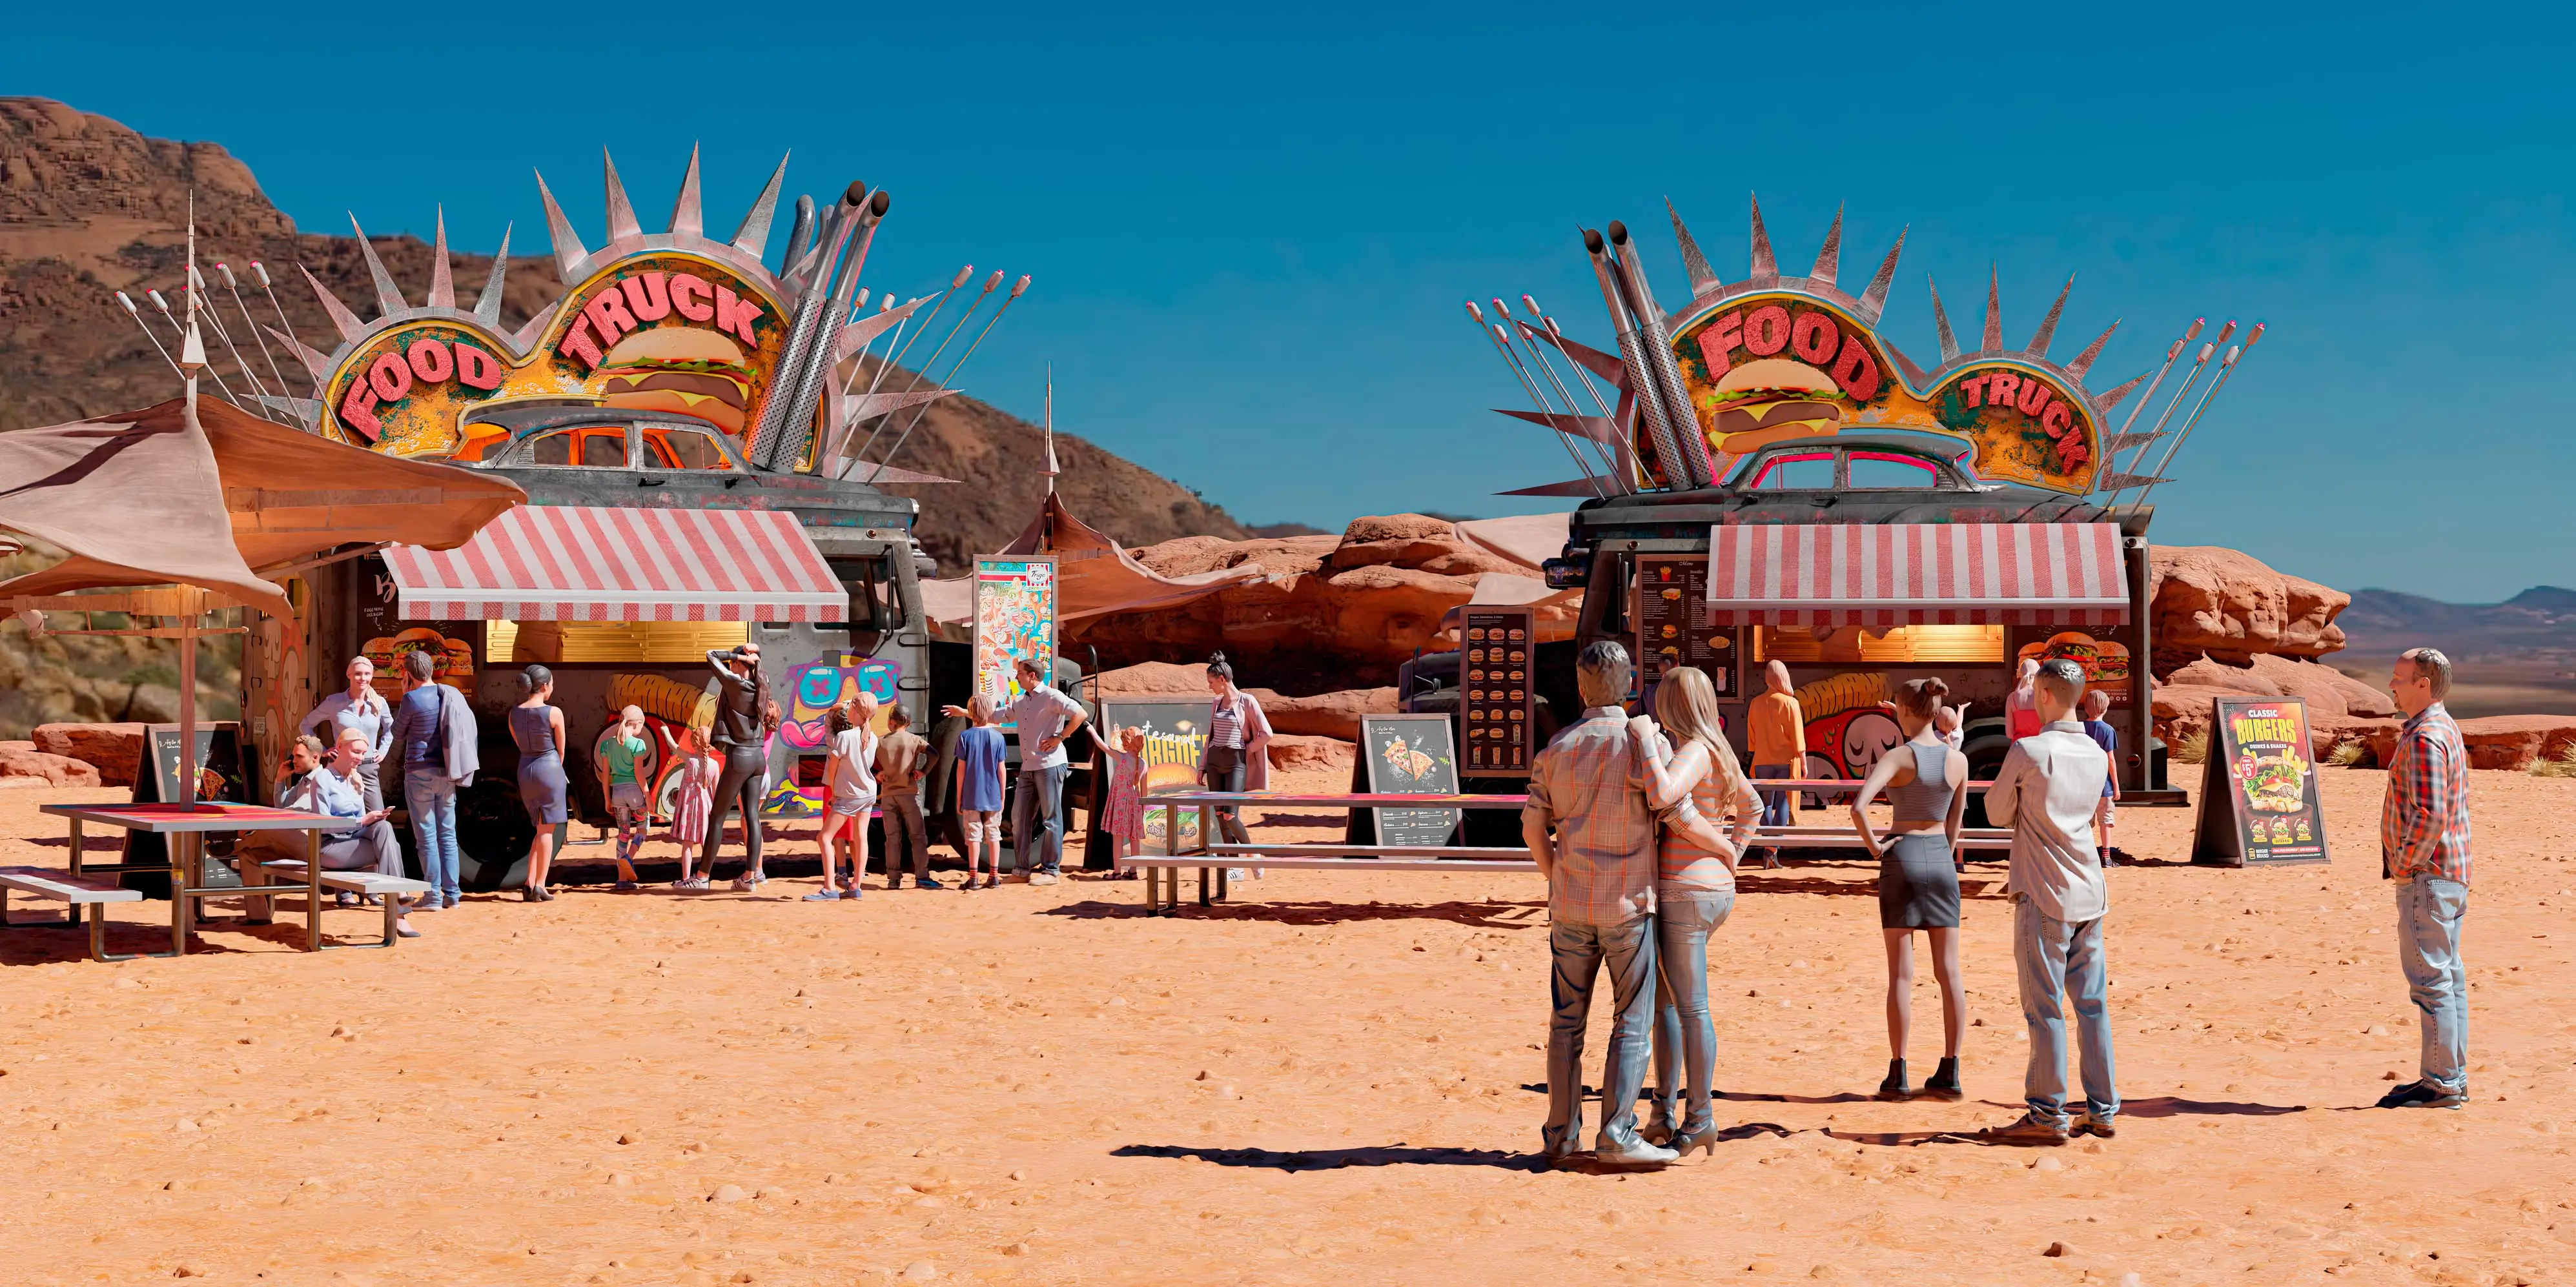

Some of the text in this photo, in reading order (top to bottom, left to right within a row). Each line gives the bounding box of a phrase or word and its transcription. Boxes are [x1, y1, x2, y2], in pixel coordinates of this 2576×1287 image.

[341, 272, 764, 441] FOOD TRUCK
[1697, 305, 2089, 474] FOOD TRUCK
[2235, 719, 2296, 744] BURGERS
